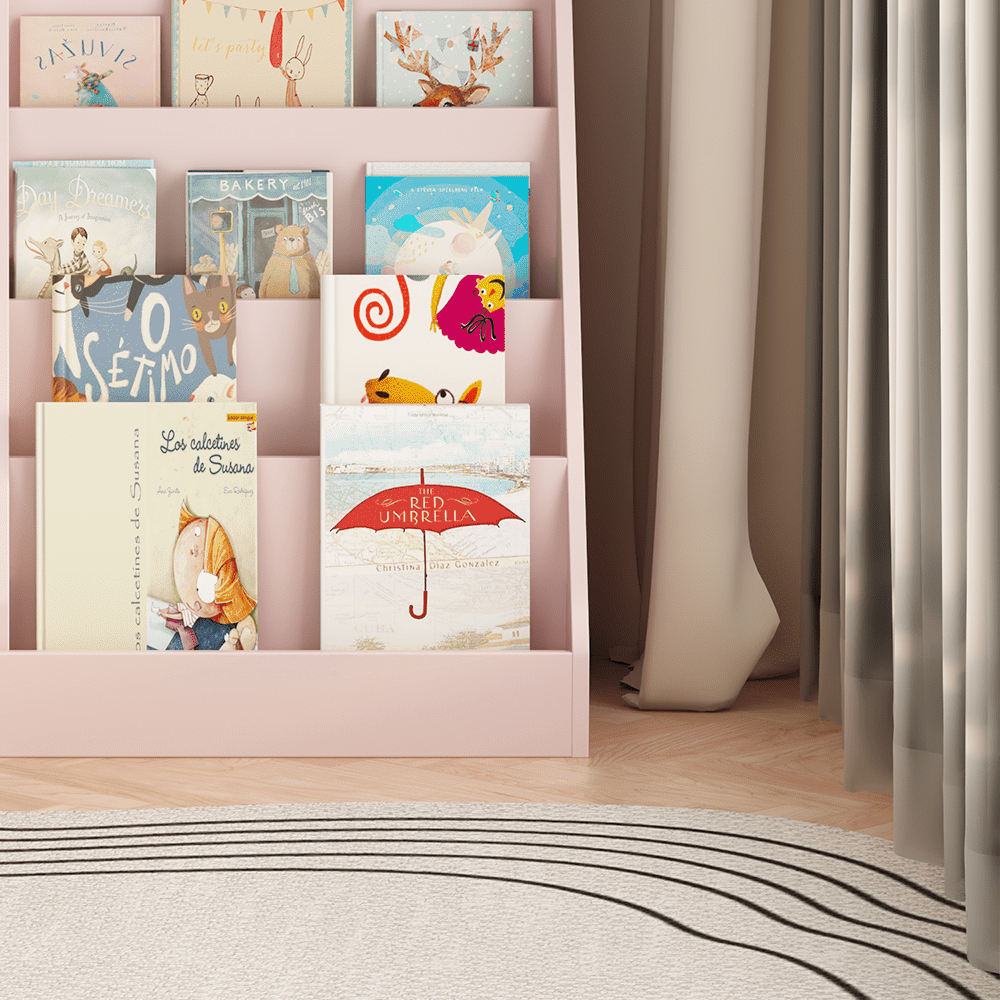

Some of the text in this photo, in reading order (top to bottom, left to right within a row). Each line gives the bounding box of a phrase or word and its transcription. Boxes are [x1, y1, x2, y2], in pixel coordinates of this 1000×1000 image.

[192, 36, 267, 64] let's party
[16, 173, 151, 219] Day Dreamers
[219, 178, 289, 192] BAKERY
[140, 292, 171, 353] O
[159, 429, 241, 454] Los calcetines
[129, 428, 142, 502] Susana
[193, 454, 255, 475] de Susana
[410, 496, 445, 509] RED
[418, 487, 435, 496] THE
[130, 507, 141, 530] de
[379, 509, 477, 526] UMBRELLA
[130, 535, 142, 627] calcetines
